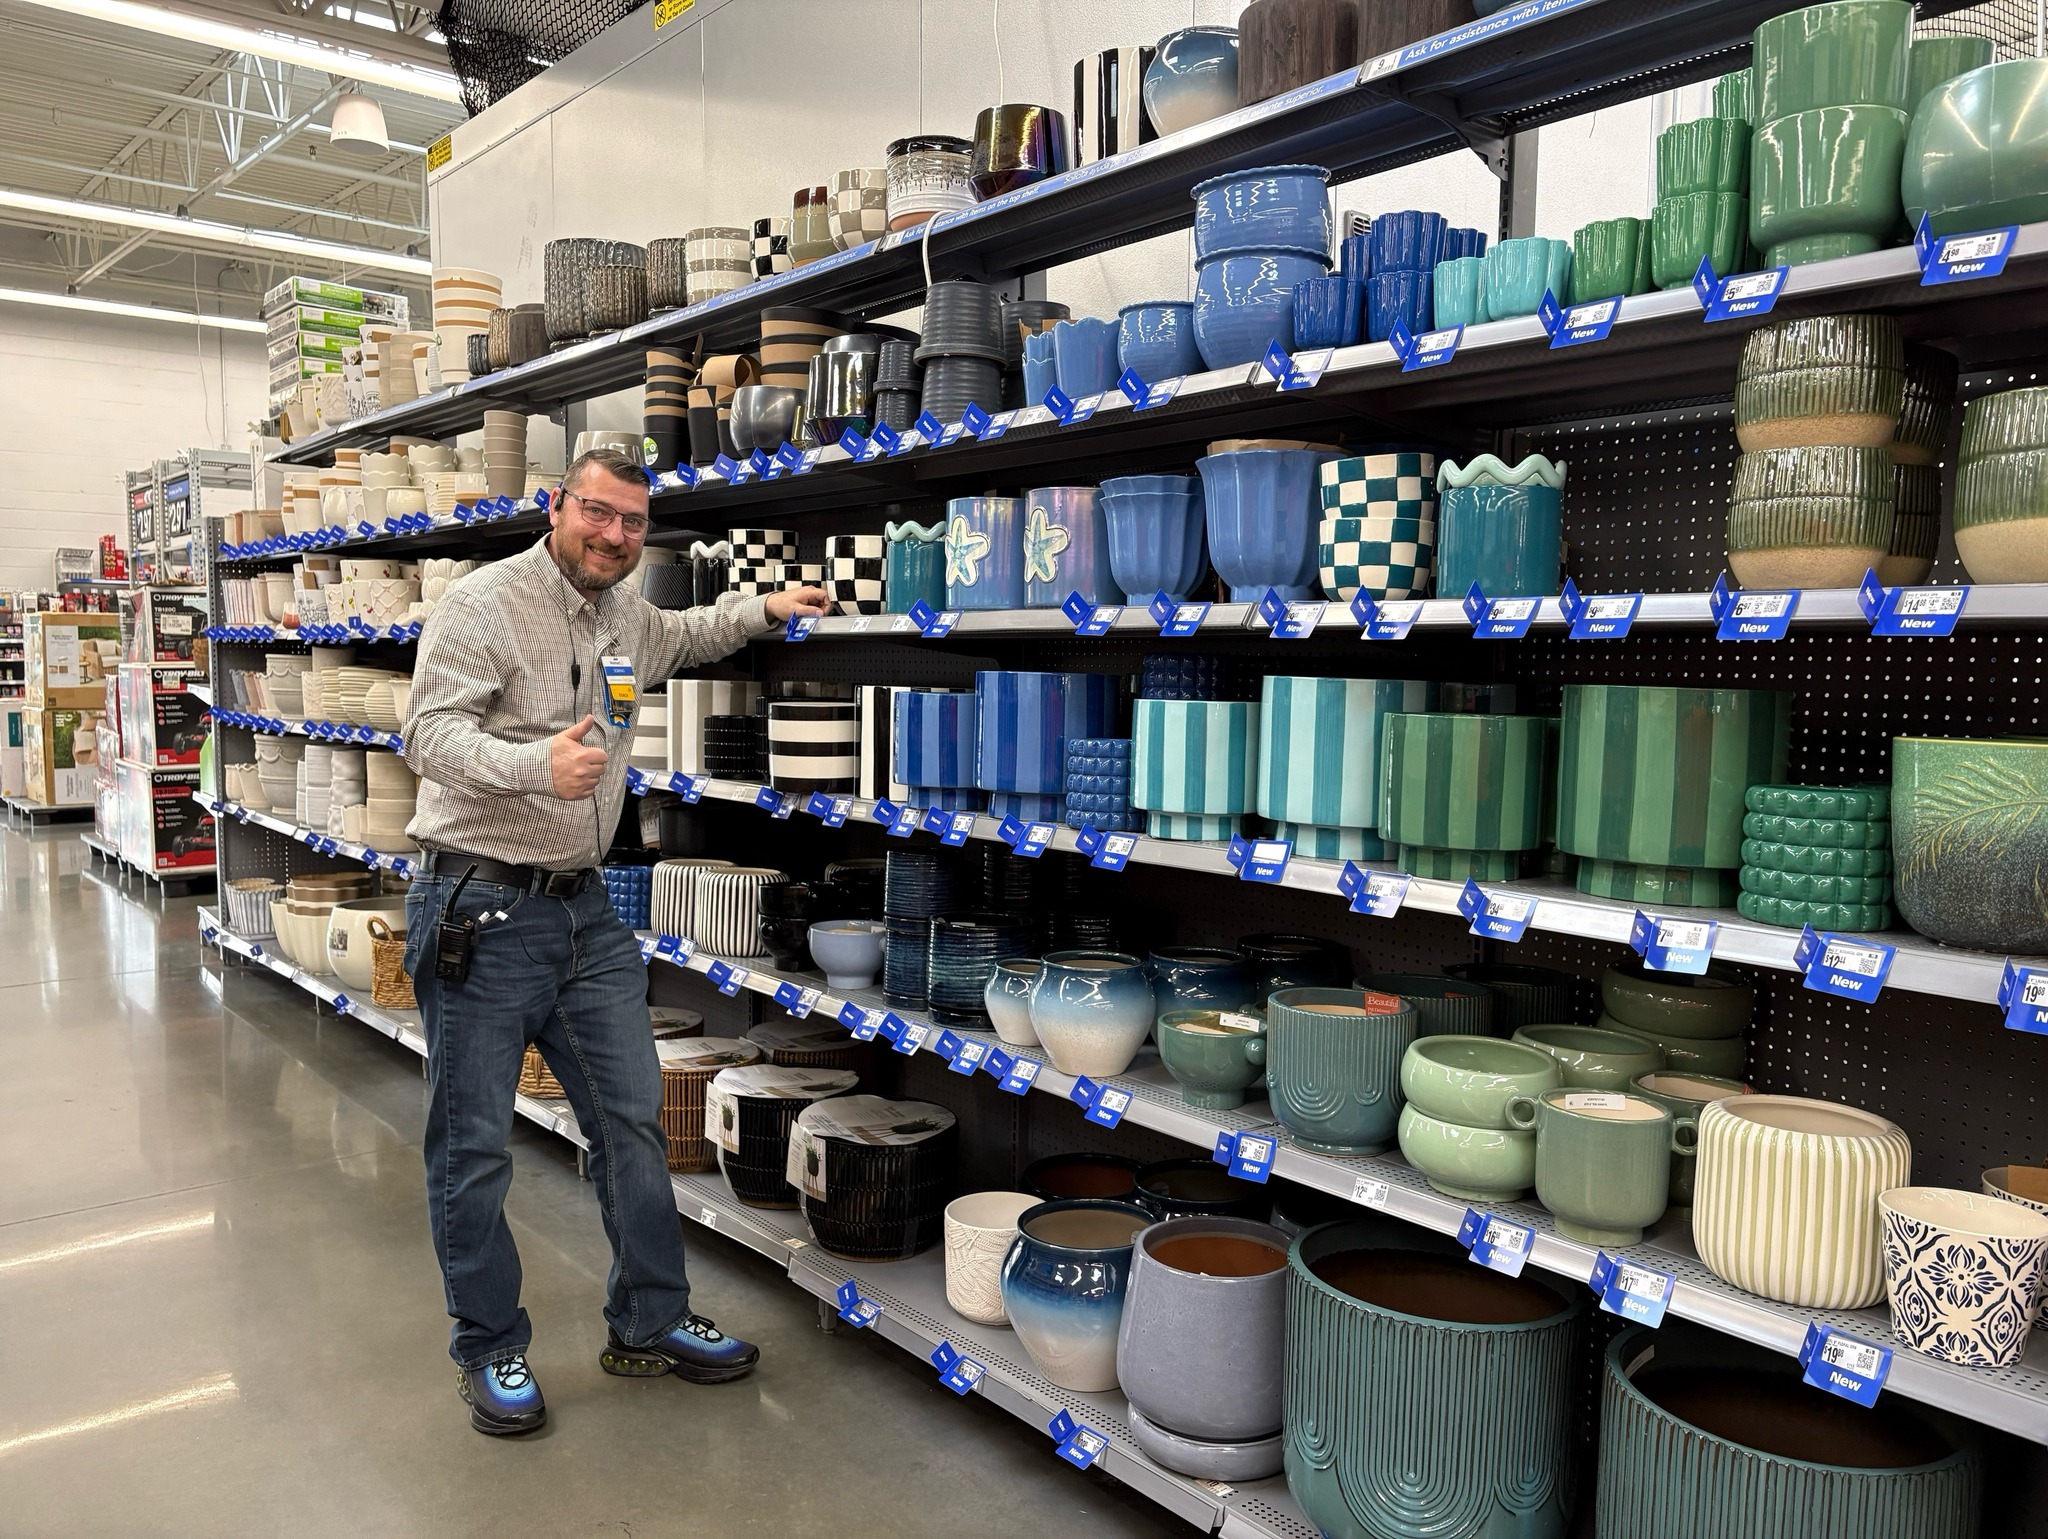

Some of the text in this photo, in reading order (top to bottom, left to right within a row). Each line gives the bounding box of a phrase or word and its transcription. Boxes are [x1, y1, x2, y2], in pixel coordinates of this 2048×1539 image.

[1404, 44, 1428, 61] Ask
[1430, 39, 1448, 53] for
[1449, 17, 1510, 46] assistance
[1512, 5, 1539, 22] with
[1949, 263, 1986, 275] New
[1700, 273, 1710, 292] New
[1728, 301, 1760, 312] New
[1544, 304, 1554, 321] New
[1395, 331, 1406, 347] New
[1570, 328, 1598, 340] New
[1420, 353, 1443, 364] New
[1292, 375, 1312, 384] New
[1865, 586, 1876, 605] New
[1070, 601, 1081, 614] New
[1087, 623, 1103, 631] New
[1173, 623, 1190, 632] New
[1285, 624, 1304, 633] New
[1491, 624, 1516, 633] New
[1589, 623, 1616, 633] New
[1738, 623, 1770, 633] New
[1899, 618, 1937, 629] New
[1378, 625, 1400, 634] New
[879, 806, 890, 817] New
[930, 816, 942, 826] New
[1004, 824, 1016, 835] New
[1082, 835, 1094, 846] New
[1023, 843, 1039, 853] New
[1232, 846, 1243, 857] New
[1102, 855, 1119, 865] New
[1255, 866, 1275, 877] New
[1344, 873, 1355, 886] New
[1366, 899, 1389, 911] New
[1464, 893, 1475, 907] New
[1487, 920, 1513, 934] New
[1665, 951, 1694, 964] New
[1829, 974, 1863, 991] New
[1367, 996, 1399, 1008] Beautiful
[844, 1010, 855, 1020] New
[886, 1021, 898, 1032] New
[942, 1039, 953, 1050] New
[958, 1059, 973, 1069] New
[991, 1057, 1002, 1069] New
[1009, 1078, 1024, 1089] New
[1078, 1086, 1090, 1098] New
[1097, 1109, 1112, 1121] New
[1242, 1162, 1261, 1174] New
[1488, 1249, 1513, 1265] New
[1622, 1297, 1650, 1315] New
[848, 1313, 861, 1323] New
[939, 1350, 948, 1362] New
[950, 1376, 965, 1387] New
[1828, 1371, 1862, 1392] New
[1057, 1419, 1066, 1432] New
[1068, 1447, 1085, 1460] New
